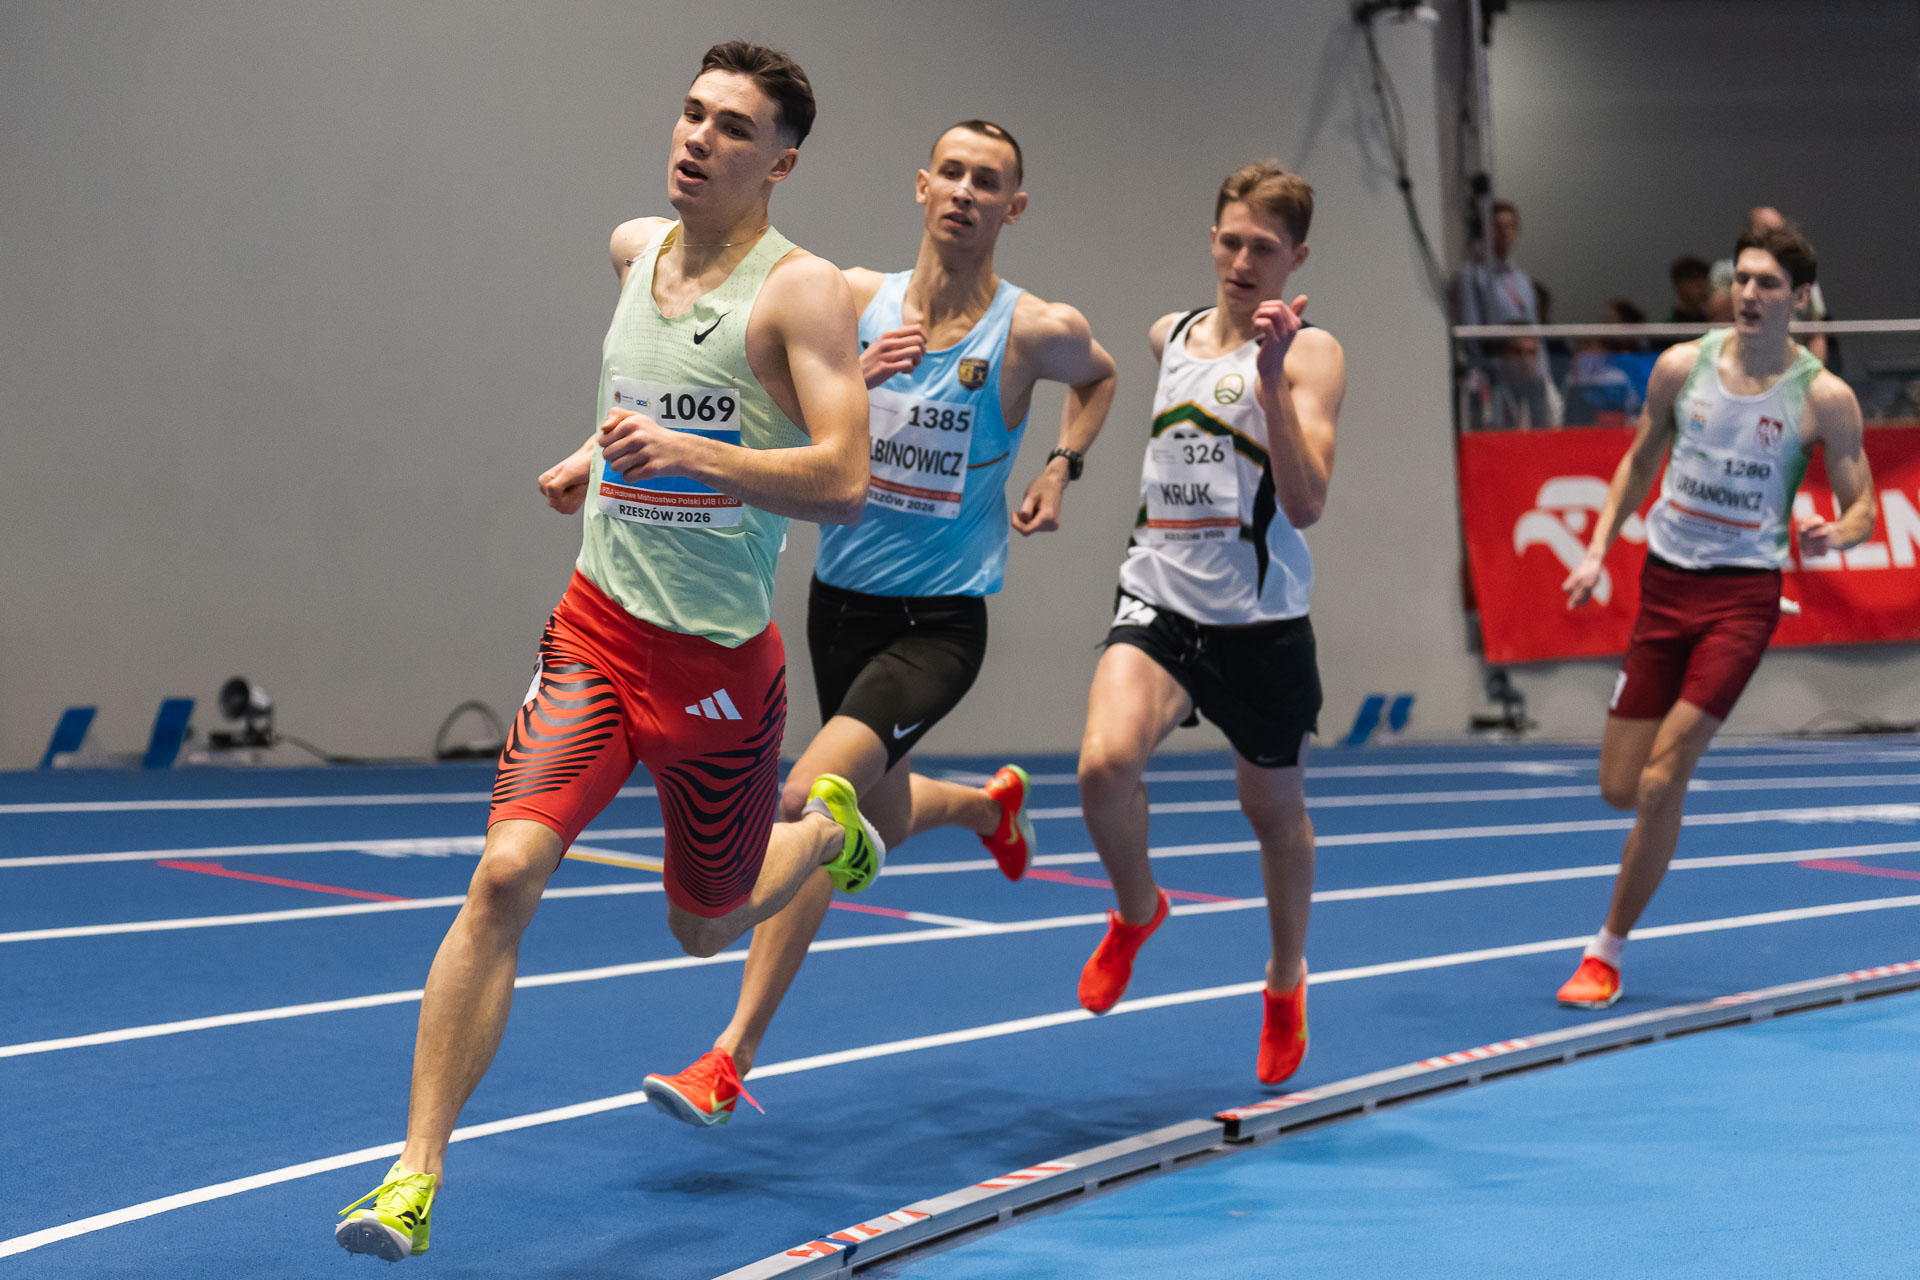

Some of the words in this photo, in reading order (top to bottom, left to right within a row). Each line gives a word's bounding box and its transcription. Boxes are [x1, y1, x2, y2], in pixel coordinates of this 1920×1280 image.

[659, 393, 735, 422] 1069
[908, 405, 970, 432] 1385
[1183, 443, 1225, 465] 326
[615, 489, 637, 499] Halowe
[637, 493, 677, 504] Mistrzostwa
[678, 497, 701, 506] Polski
[702, 498, 716, 506] U18
[722, 497, 738, 505] U20
[1161, 482, 1214, 506] KRUK
[618, 504, 674, 521] RZESZÓW
[677, 511, 711, 523] 2026
[907, 499, 936, 513] 2026
